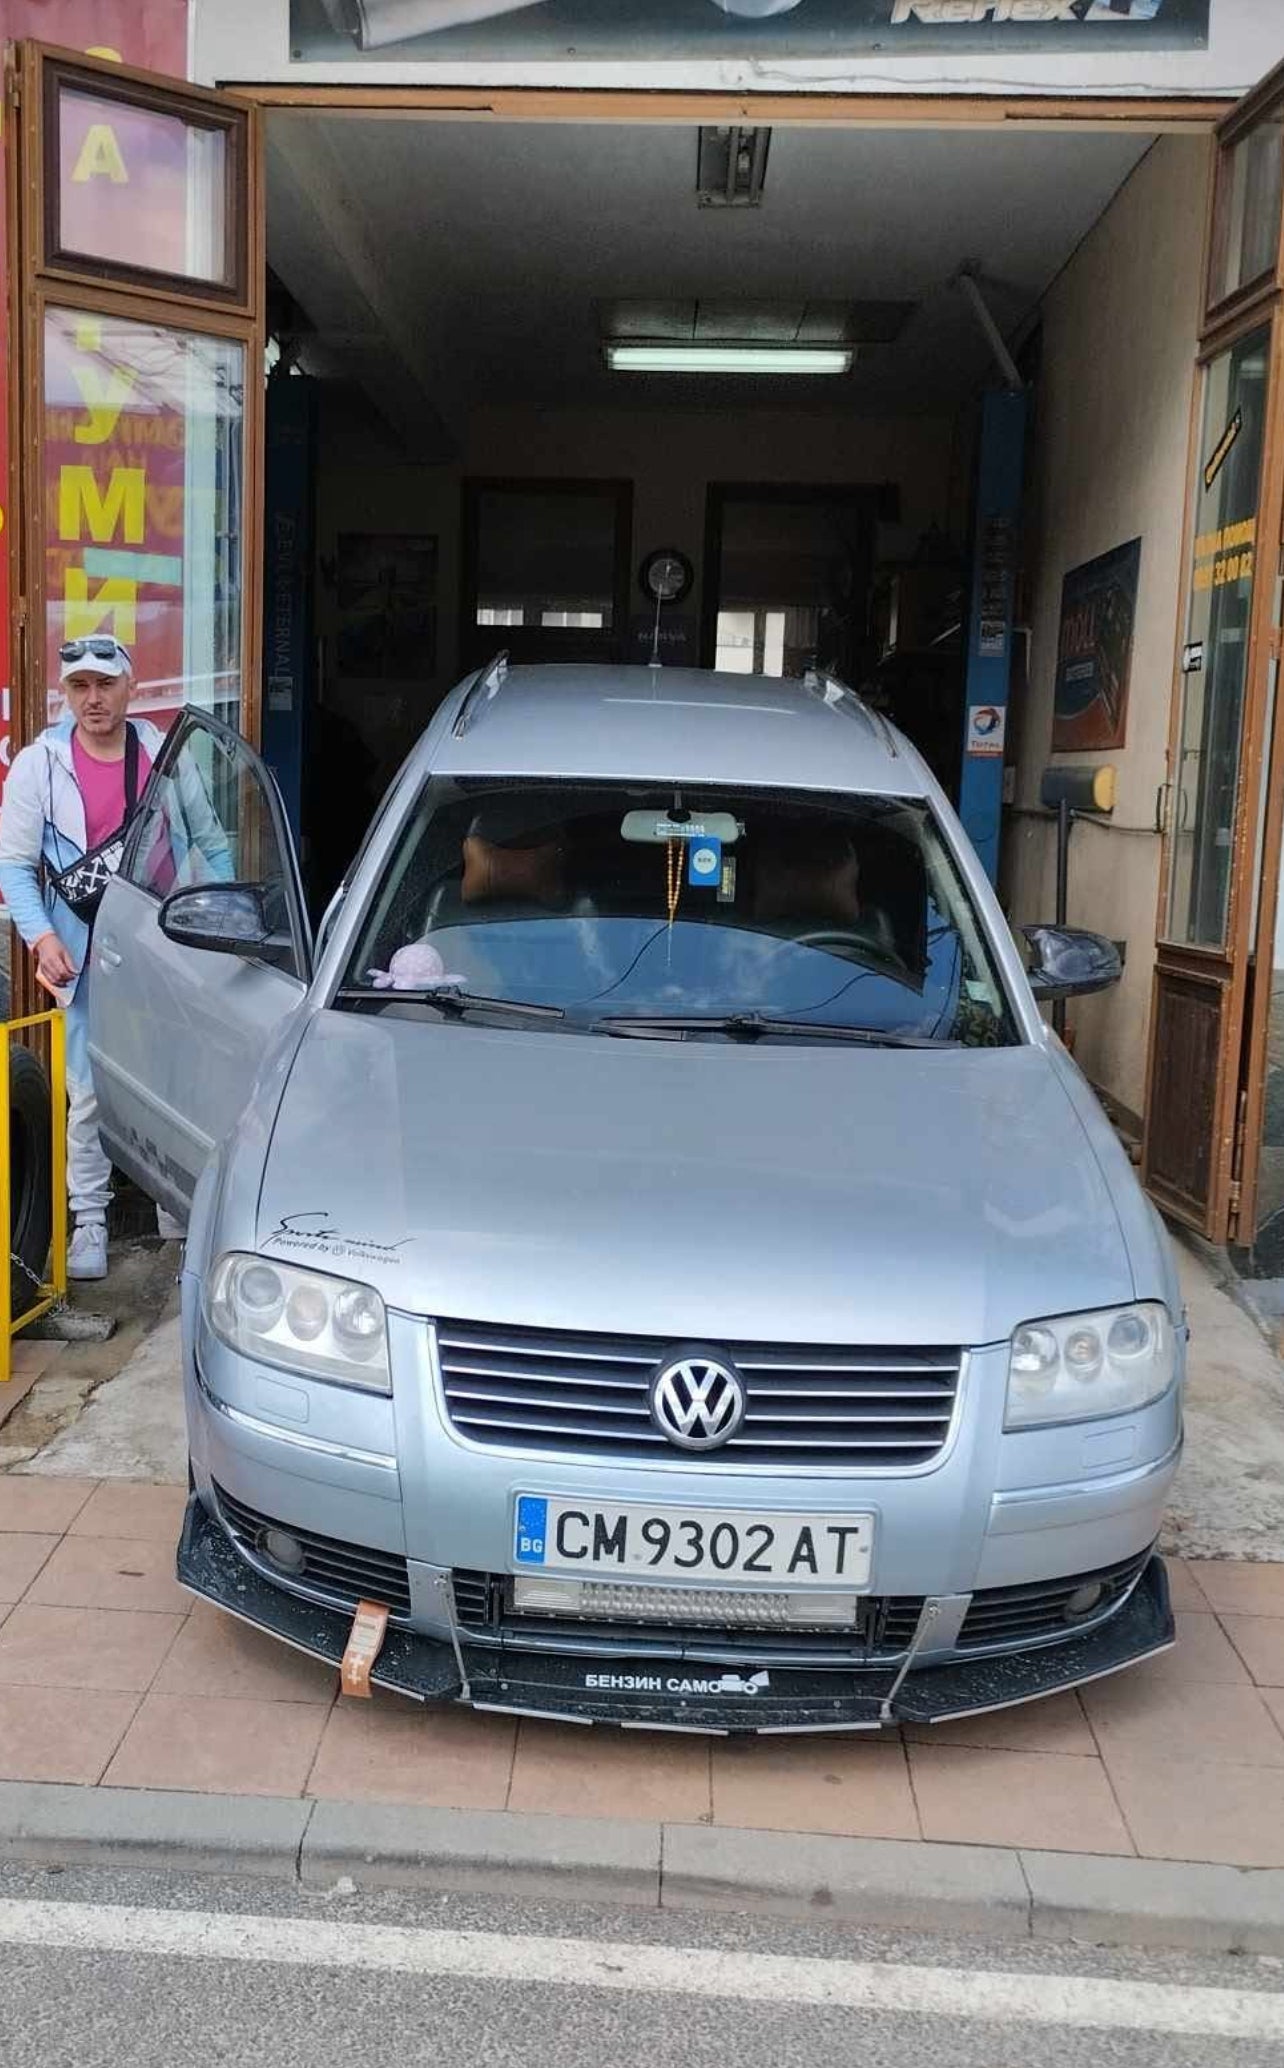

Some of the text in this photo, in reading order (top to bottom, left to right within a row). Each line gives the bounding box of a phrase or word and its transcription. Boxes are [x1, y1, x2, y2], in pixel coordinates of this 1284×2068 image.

[273, 1236, 318, 1250] Powered
[318, 1243, 330, 1253] by
[655, 1360, 742, 1447] VW
[520, 1538, 543, 1553] BG
[556, 1511, 859, 1574] CM 9302 AT
[585, 1674, 722, 1693] БЕНЗИН САМО
